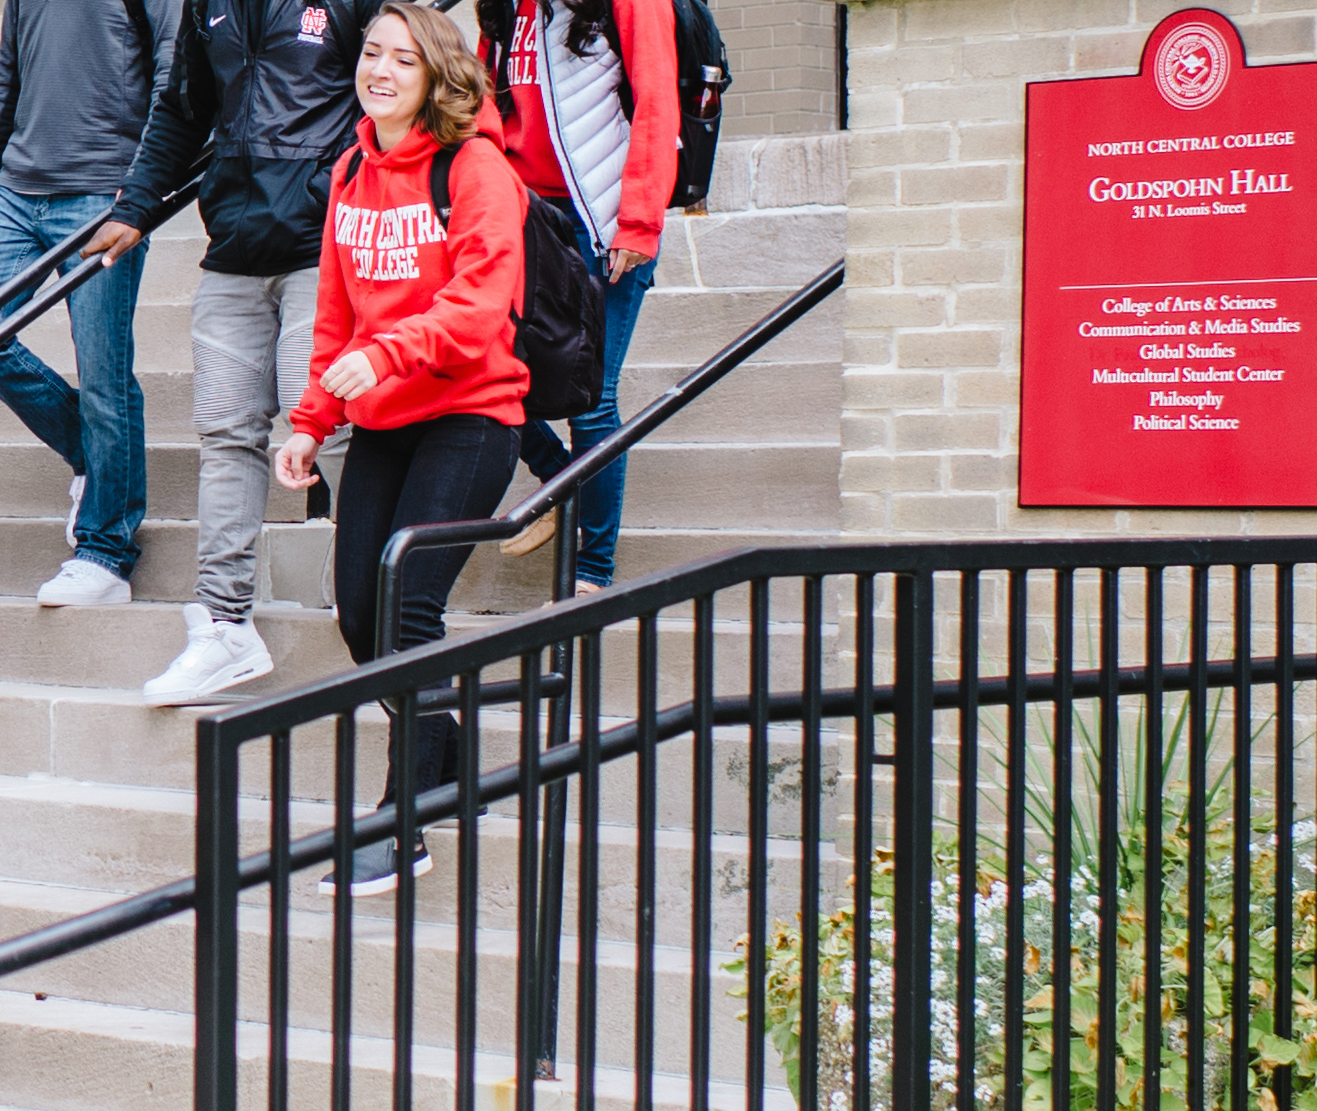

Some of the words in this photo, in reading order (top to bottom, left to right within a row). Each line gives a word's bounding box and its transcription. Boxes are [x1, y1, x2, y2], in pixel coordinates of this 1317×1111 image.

[1088, 141, 1144, 157] NORTH
[1147, 136, 1220, 153] CENTRAL
[1223, 131, 1295, 148] COLLEGE
[1132, 205, 1145, 218] 31
[1148, 204, 1164, 218] N.
[1167, 202, 1210, 217] Loomis
[1212, 201, 1247, 215] Street
[376, 203, 447, 250] CENTRA
[1102, 297, 1153, 316] College
[1155, 296, 1172, 312] of
[1172, 296, 1202, 312] Arts
[1204, 296, 1217, 311] &
[1220, 294, 1277, 310] Sciences
[1079, 320, 1186, 337] Communication
[1188, 320, 1203, 335] &
[1205, 319, 1248, 334] Media
[1250, 317, 1301, 333] Studies
[1140, 344, 1184, 359] Global
[1187, 342, 1236, 358] Studies
[1092, 367, 1180, 384] Multicultural
[1182, 366, 1235, 382] Student
[1237, 365, 1285, 382] Center
[1150, 390, 1224, 410] Philosophy
[1134, 414, 1186, 430] Political
[1189, 414, 1239, 430] Science
